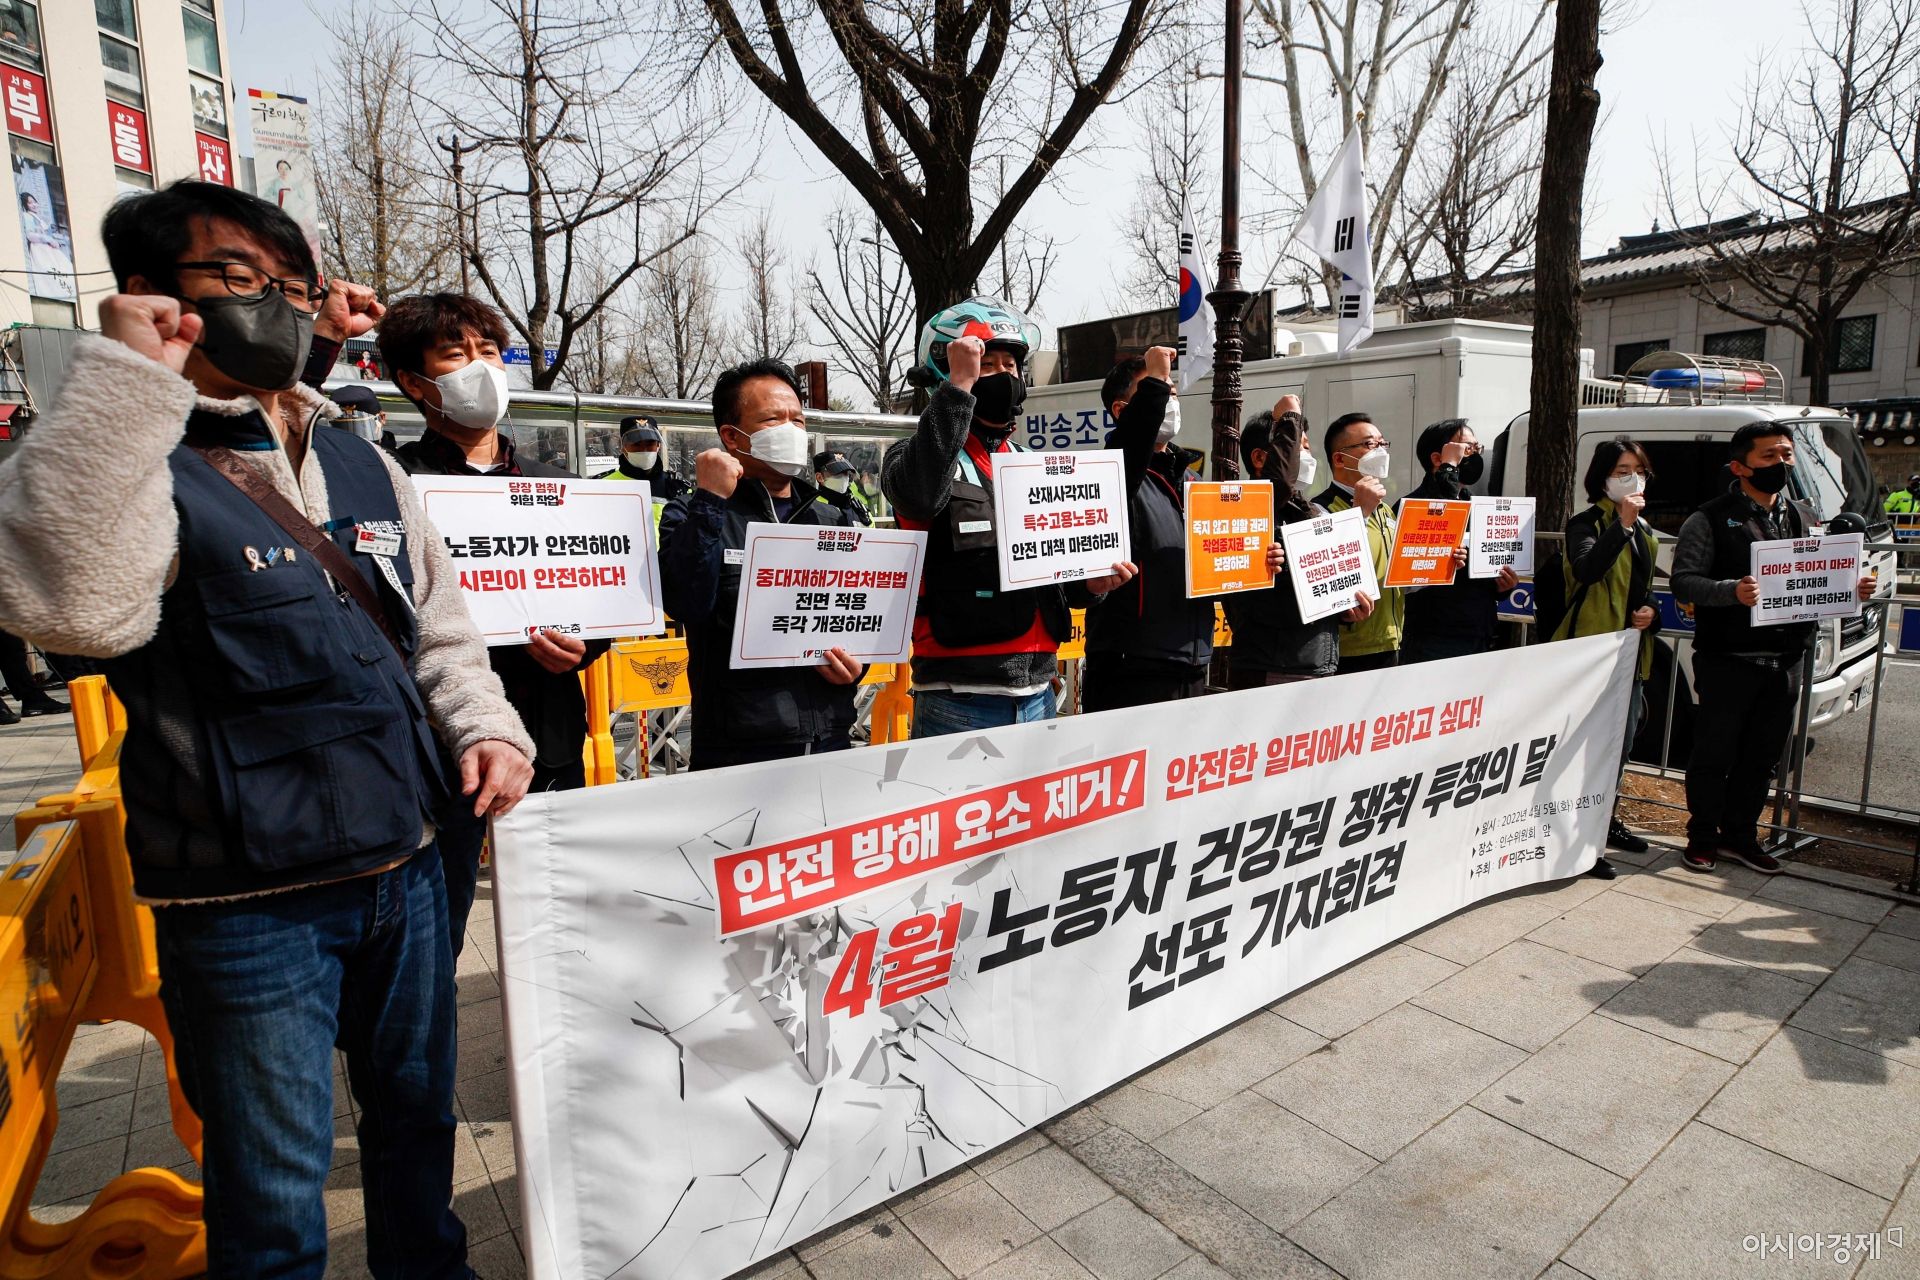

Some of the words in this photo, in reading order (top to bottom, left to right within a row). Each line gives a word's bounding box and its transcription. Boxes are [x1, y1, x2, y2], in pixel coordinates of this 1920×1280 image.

[114, 122, 142, 165] 동
[1045, 456, 1057, 465] 당장
[1059, 455, 1071, 464] 멈춰
[1045, 466, 1059, 475] 위험
[508, 482, 532, 493] 당장
[535, 482, 557, 494] 멈춰
[1028, 483, 1101, 504] 산재사각지대
[510, 494, 534, 506] 위험
[1024, 508, 1108, 531] 특수고용노동자
[1193, 520, 1210, 535] 죽지
[1213, 519, 1229, 534] 않고
[1232, 519, 1248, 533] 일할
[1250, 518, 1268, 532] 권리!
[1487, 516, 1493, 525] 더
[1495, 516, 1518, 525] 안전하게
[818, 530, 836, 540] 당장
[838, 531, 856, 541] 멈춰
[1486, 529, 1492, 539] 더
[1494, 529, 1518, 539] 건강하게
[546, 534, 630, 557] 안전해야
[817, 541, 835, 551] 위험
[1011, 541, 1037, 561] 안전
[1041, 538, 1065, 557] 대책
[1069, 532, 1119, 554] 마련하라!
[1203, 536, 1259, 553] 작업중지권으로
[1299, 549, 1329, 568] 산업단지
[1331, 540, 1361, 559] 노후설비
[1481, 541, 1523, 552] 건설안전특별법
[1214, 555, 1249, 572] 보장하라!
[1306, 564, 1337, 583] 안전관리
[1338, 556, 1360, 572] 특별법
[1489, 555, 1514, 565] 제정하라!
[1761, 563, 1792, 575] 더이상
[1795, 560, 1826, 572] 죽이지
[1830, 558, 1854, 569] 마라!
[459, 568, 527, 592] 시민이
[533, 565, 626, 590] 안전하다!
[756, 568, 908, 589] 중대재해기업처벌법
[1312, 583, 1328, 597] 즉각
[1329, 572, 1361, 593] 제정하라!
[1786, 577, 1827, 590] 중대재해
[795, 592, 830, 611] 전면
[834, 592, 867, 610] 적용
[1762, 595, 1802, 609] 근본대책
[1806, 591, 1851, 605] 마련하라!
[772, 615, 808, 634] 즉각
[811, 615, 882, 633] 개정하라!
[1166, 742, 1258, 801] 안전한
[1264, 720, 1366, 777] 일터에서
[1370, 706, 1435, 751] 일하고
[1439, 696, 1483, 736] 싶다!
[1501, 808, 1528, 827] 2022년
[1528, 804, 1540, 818] 4월
[1543, 800, 1574, 815] 5일(화)
[1575, 796, 1590, 809] 오전
[733, 840, 835, 916] 안전
[852, 811, 939, 878] 방해
[953, 791, 1031, 851] 요소
[1043, 758, 1139, 825] 제거!
[1500, 825, 1536, 849] 인수위원회
[1542, 824, 1551, 838] 앞
[1509, 845, 1546, 866] 민주노총
[822, 901, 963, 1019] 4월
[977, 841, 1177, 973] 노동자
[1186, 796, 1337, 901] 건강권
[1339, 772, 1424, 848] 쟁취
[1421, 742, 1520, 818] 투쟁의
[1519, 733, 1557, 788] 달
[1128, 903, 1232, 1011] 선포
[1241, 840, 1407, 960] 기자회견
